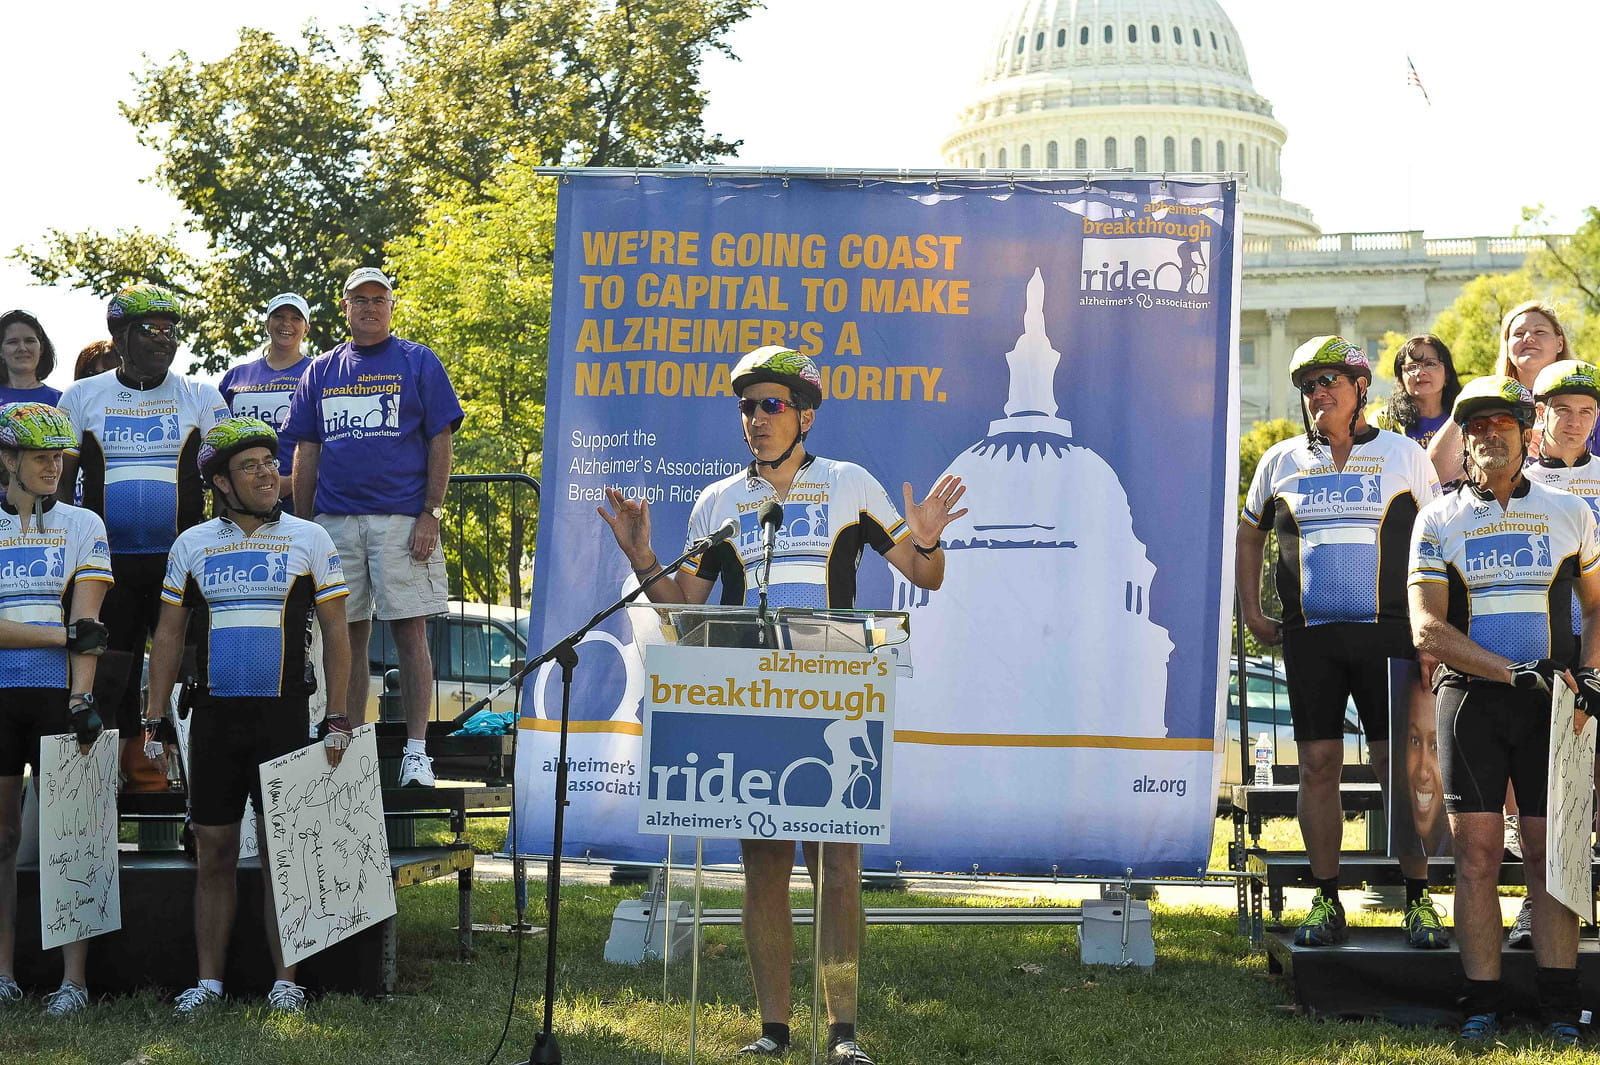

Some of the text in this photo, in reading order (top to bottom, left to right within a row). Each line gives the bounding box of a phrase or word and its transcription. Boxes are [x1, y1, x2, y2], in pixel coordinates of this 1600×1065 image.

[1082, 217, 1211, 242] breakthrough
[582, 230, 962, 270] WE'RE GOING COAST
[1083, 261, 1150, 292] ride
[579, 273, 970, 315] TO CAPITAL TO MAKE
[1079, 296, 1134, 306] alzheimer's
[575, 317, 862, 357] ALZHEIMER'S A
[233, 382, 299, 392] breakthrou
[357, 374, 402, 382] alzheimer's
[574, 361, 947, 402] NATIONA IORITY.
[322, 383, 401, 398] breakthrough
[105, 405, 178, 417] breakthrough
[234, 405, 271, 421] ride
[325, 410, 361, 431] ride
[103, 426, 145, 442] ride
[571, 429, 656, 452] Support the
[569, 456, 742, 476] Alzheimer's Association
[669, 485, 700, 502] Ride
[1304, 488, 1342, 505] ide
[741, 524, 790, 547] rie
[1463, 521, 1549, 538] breakthrough
[0, 536, 67, 547] akthrough
[204, 540, 290, 555] breakthrough
[1466, 549, 1512, 572] ride
[204, 566, 247, 586] ride
[758, 652, 888, 677] alzheimer's
[649, 674, 886, 721] breakthrough
[542, 757, 636, 776] alheimer's
[567, 777, 640, 797] associati
[652, 752, 772, 805] ride
[1133, 775, 1187, 797] alz.org
[646, 812, 742, 830] alzheimer's
